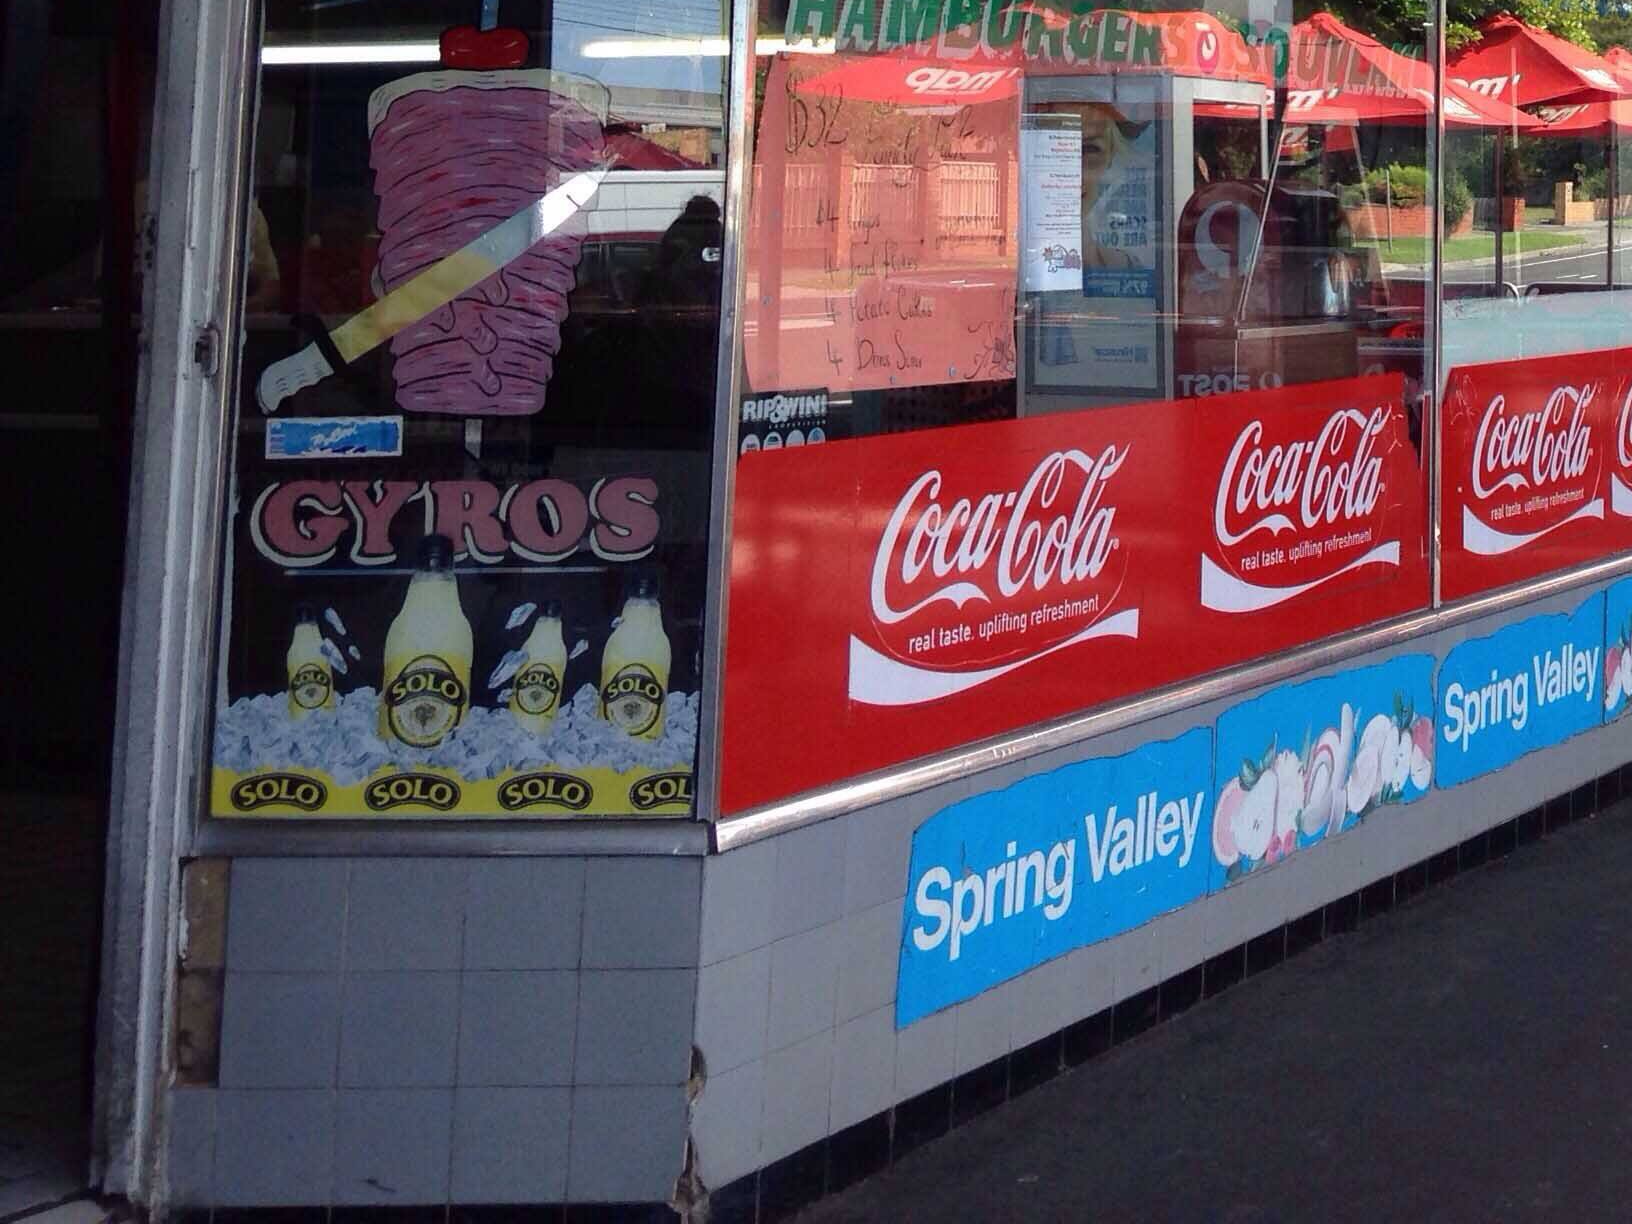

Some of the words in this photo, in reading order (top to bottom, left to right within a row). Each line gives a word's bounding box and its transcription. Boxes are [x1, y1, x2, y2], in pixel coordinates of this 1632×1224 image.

[1474, 383, 1600, 500] Coca-Cola
[1215, 406, 1392, 547] Coca-Cola
[250, 477, 660, 567] GYROS
[870, 443, 1131, 625] Coca-Cola
[1241, 551, 1259, 571] real
[1288, 540, 1322, 564] uplifting
[1324, 528, 1372, 553] refreshment
[908, 634, 935, 654] real
[979, 613, 1027, 639] uplifting
[1030, 596, 1099, 627] refreshment
[392, 673, 461, 701] SOLO
[518, 672, 557, 688] SOLO
[607, 676, 660, 699] SOLO
[1443, 668, 1529, 752] Spring
[1532, 642, 1600, 707] Valley
[238, 778, 320, 805] SOLO
[368, 777, 453, 805] SOLO
[501, 777, 584, 805] SOLO
[635, 778, 692, 805] SOL
[911, 838, 1076, 964] Spring
[1085, 789, 1204, 885] Valley
